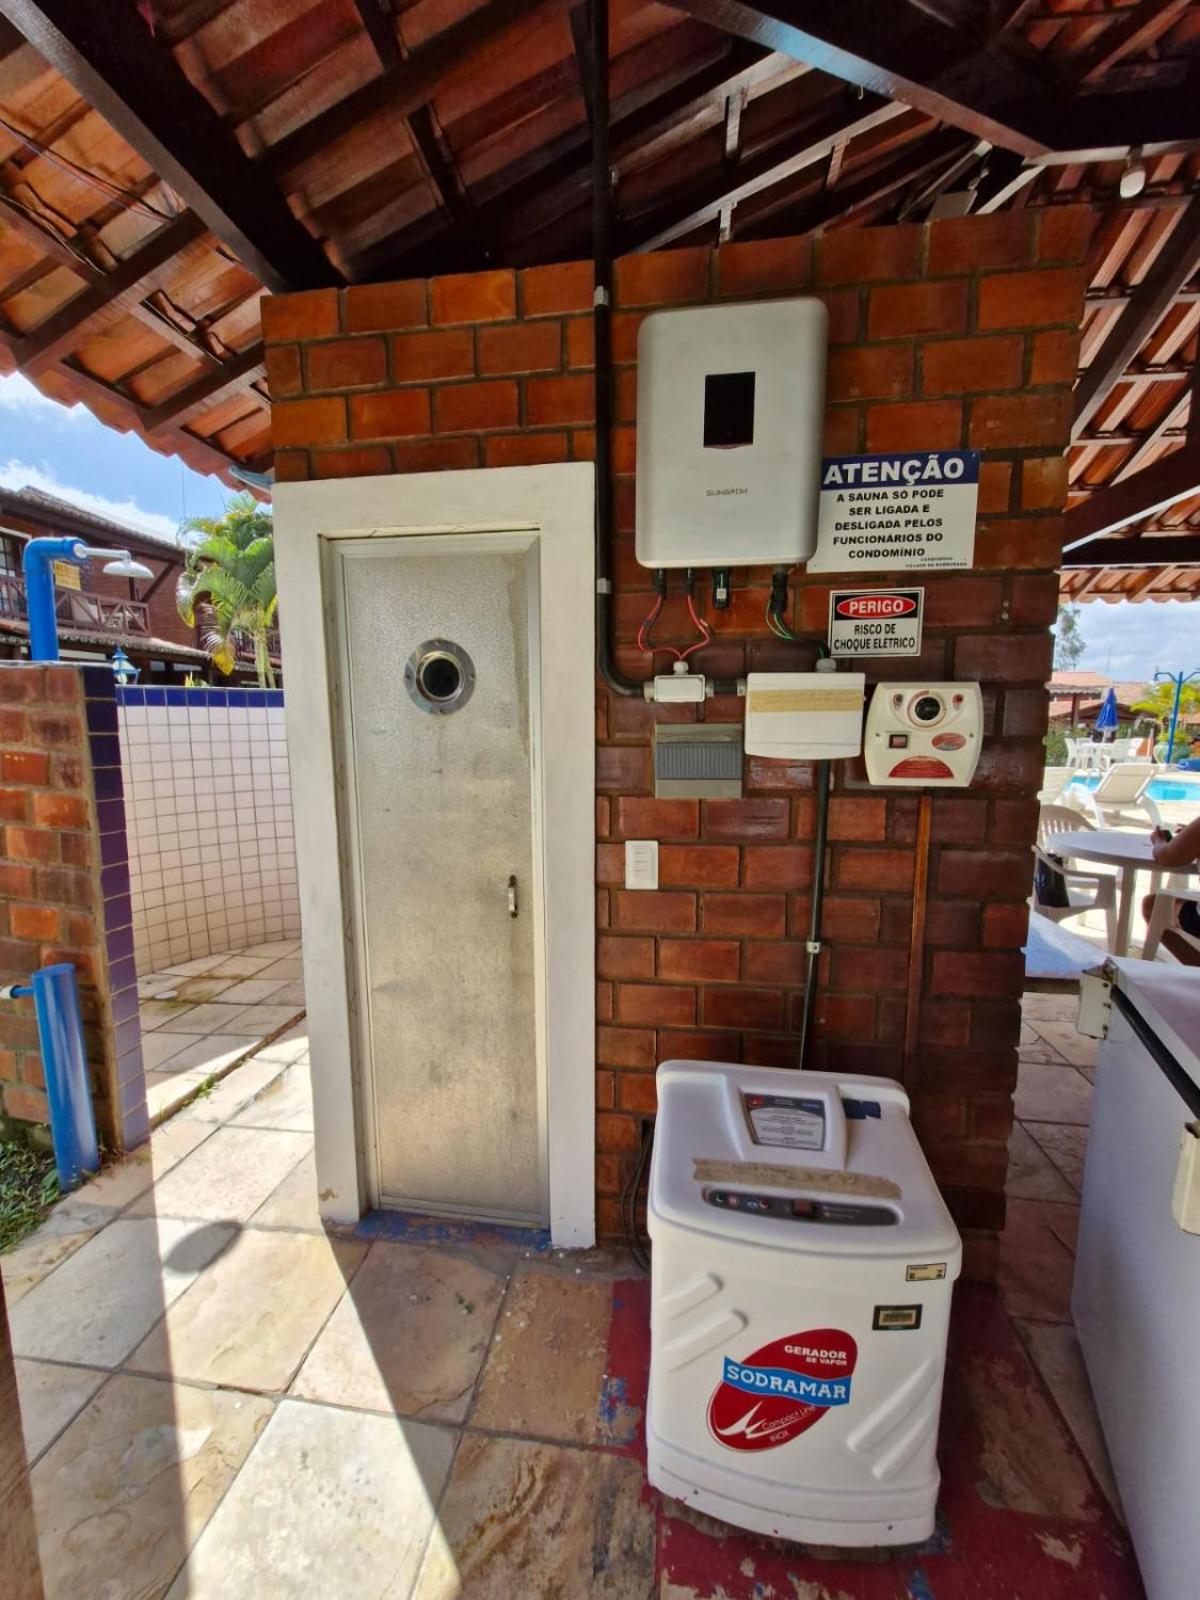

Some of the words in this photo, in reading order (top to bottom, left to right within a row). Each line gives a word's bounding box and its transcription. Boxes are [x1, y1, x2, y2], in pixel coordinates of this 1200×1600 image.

[823, 454, 964, 486] ATENÇÃO
[837, 494, 845, 502] A
[848, 491, 889, 502] SAUNA
[912, 489, 944, 499] PODE
[849, 507, 871, 516] SER
[875, 505, 919, 515] LIGADA
[922, 504, 930, 513] E
[835, 519, 901, 531] DESLIGADA
[904, 518, 943, 528] PELOS
[926, 533, 943, 542] DO
[849, 547, 925, 559] CONDOMÍNIO
[848, 599, 904, 614] PERIGO
[854, 624, 882, 635] RISCO
[884, 623, 897, 634] DE
[834, 638, 871, 652] CHOQUE
[784, 1345, 847, 1359] GERADOR
[819, 1358, 848, 1366] VAPOR
[726, 1364, 848, 1399] SODRAMAR
